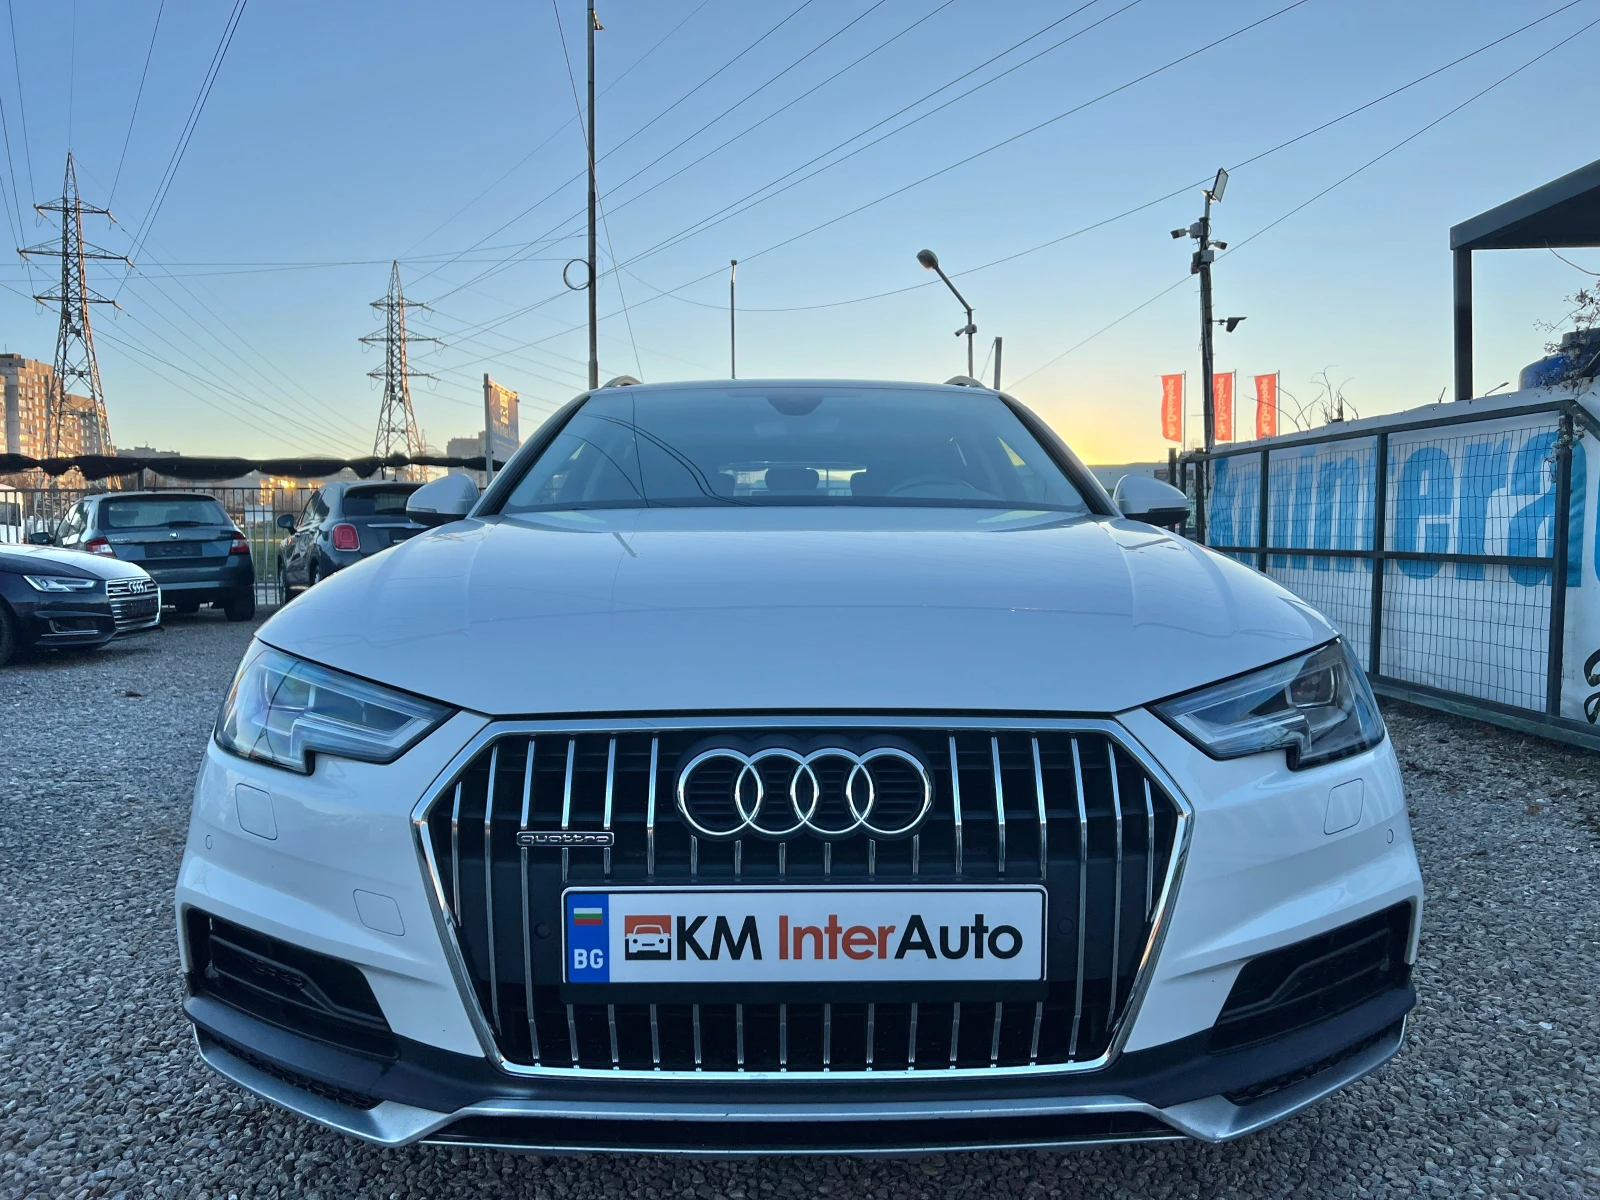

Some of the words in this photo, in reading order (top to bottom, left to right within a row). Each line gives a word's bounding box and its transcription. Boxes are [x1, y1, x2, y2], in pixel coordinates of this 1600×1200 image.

[520, 834, 610, 845] quattro
[677, 915, 762, 960] KM
[779, 914, 1023, 960] InterAuto
[574, 948, 604, 969] BG
